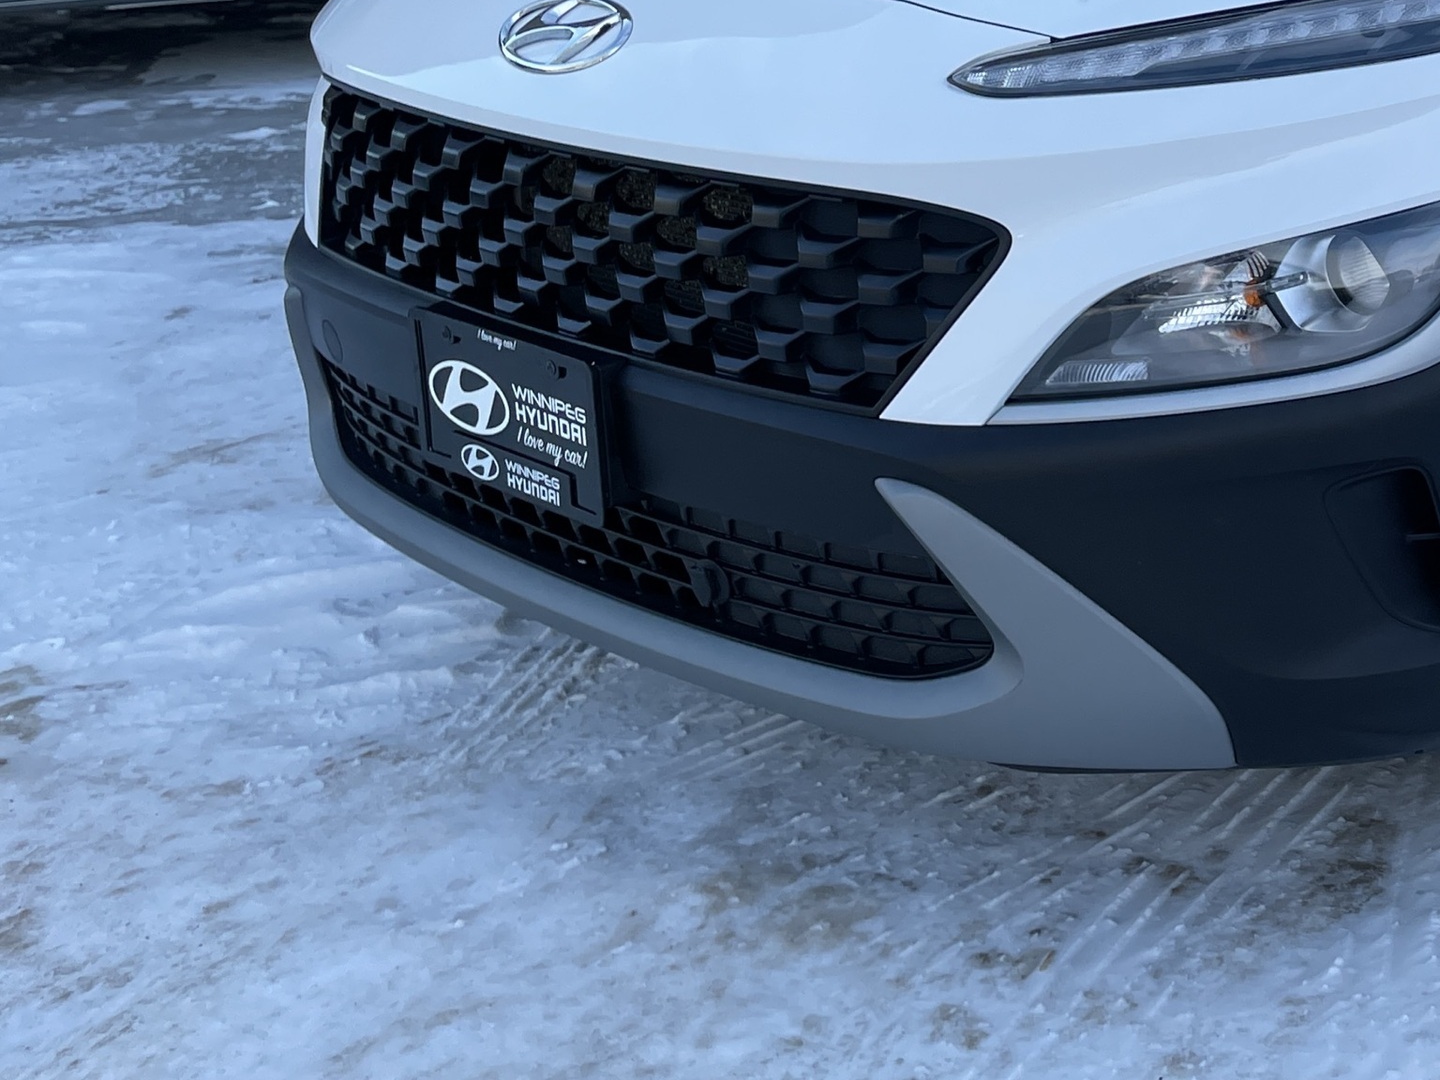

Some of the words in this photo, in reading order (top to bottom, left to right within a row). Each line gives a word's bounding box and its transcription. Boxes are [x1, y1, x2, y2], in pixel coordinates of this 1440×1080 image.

[512, 383, 586, 423] WINNIPEG
[515, 402, 587, 446] HYUNDAI
[517, 426, 522, 442] I
[524, 430, 544, 451] love
[546, 442, 563, 466] my
[564, 452, 587, 469] car!
[504, 459, 560, 489] WINNIPEG
[507, 473, 560, 506] HYUNDAI
